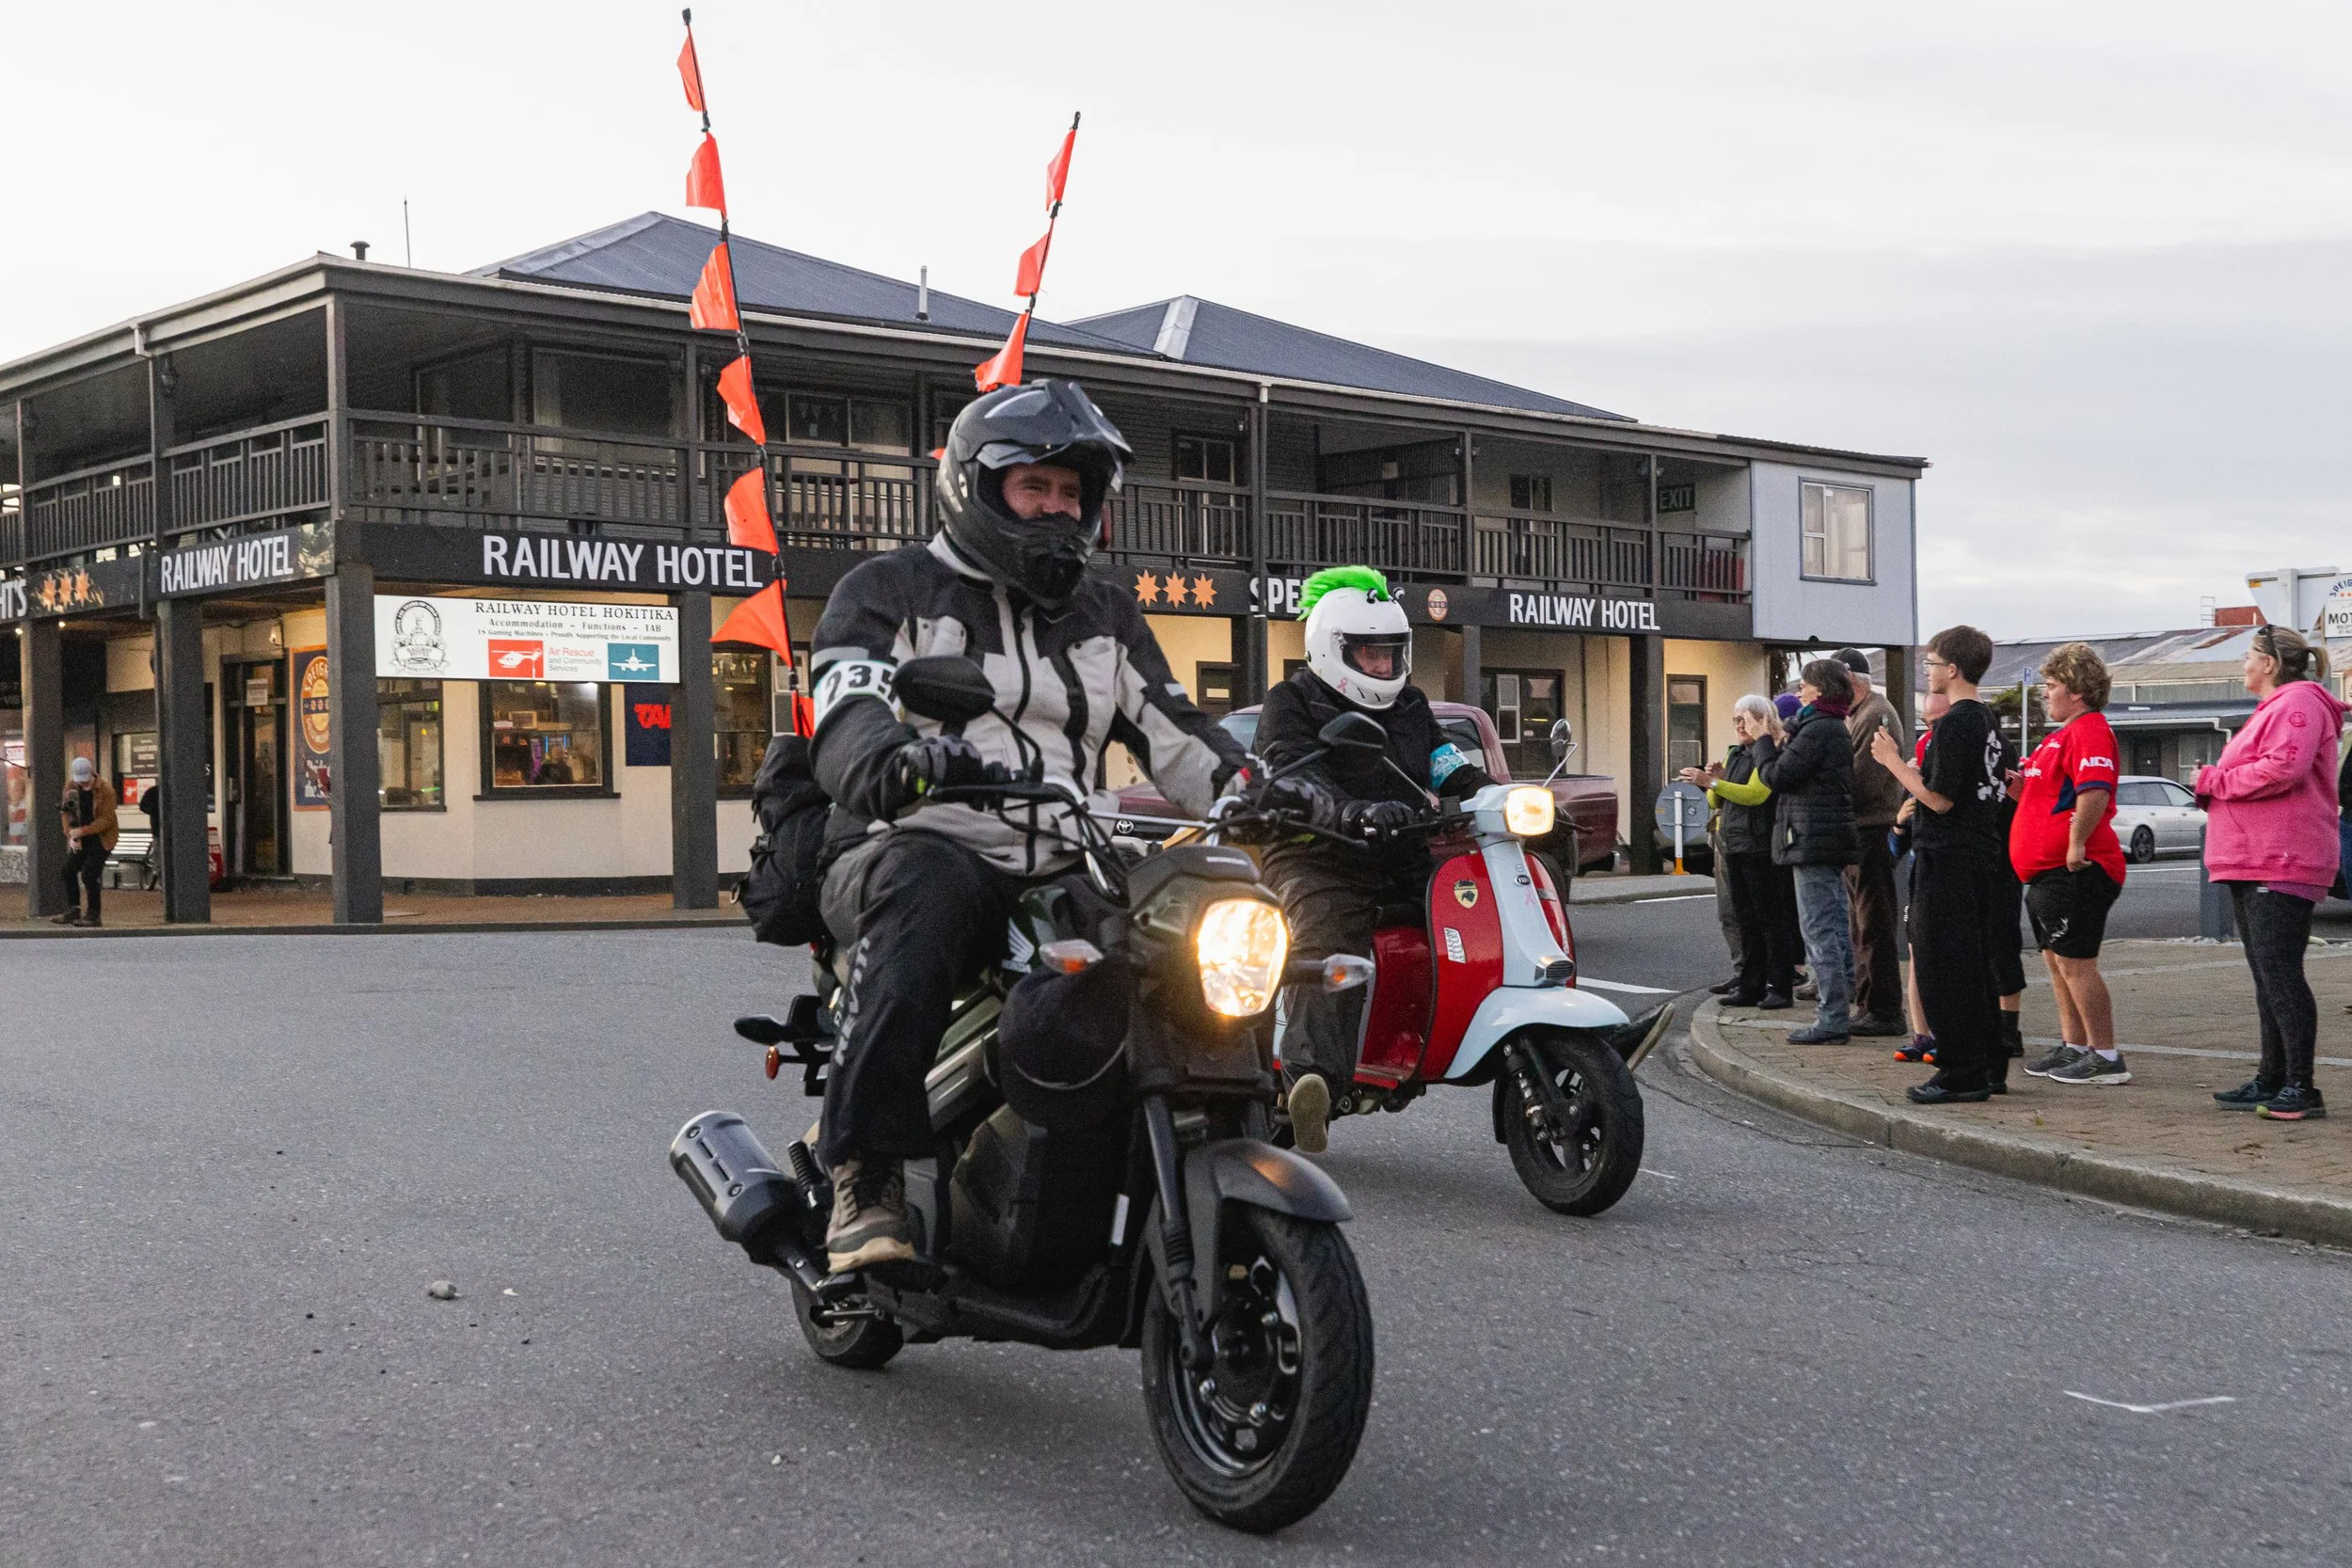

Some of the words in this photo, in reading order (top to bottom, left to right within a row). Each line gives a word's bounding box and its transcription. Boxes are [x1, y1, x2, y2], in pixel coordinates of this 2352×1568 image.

[1659, 487, 1693, 510] EXIT
[161, 544, 233, 594] RAILWAY
[236, 534, 294, 582] HOTEL
[483, 534, 644, 582] RAILWAY
[656, 544, 764, 589] HOTEL
[475, 602, 543, 615] RAILWAY
[548, 605, 597, 618] HOTEL
[603, 608, 674, 621] HOKITIKA
[1509, 594, 1597, 627] RAILWAY
[1600, 599, 1661, 631] HOTEL
[489, 618, 564, 629] Accommodation
[581, 622, 627, 631] Functions
[644, 625, 661, 633] TAB
[548, 646, 561, 656] Air
[563, 647, 596, 657] Rescue
[548, 664, 579, 673] Services
[564, 657, 602, 666] Community
